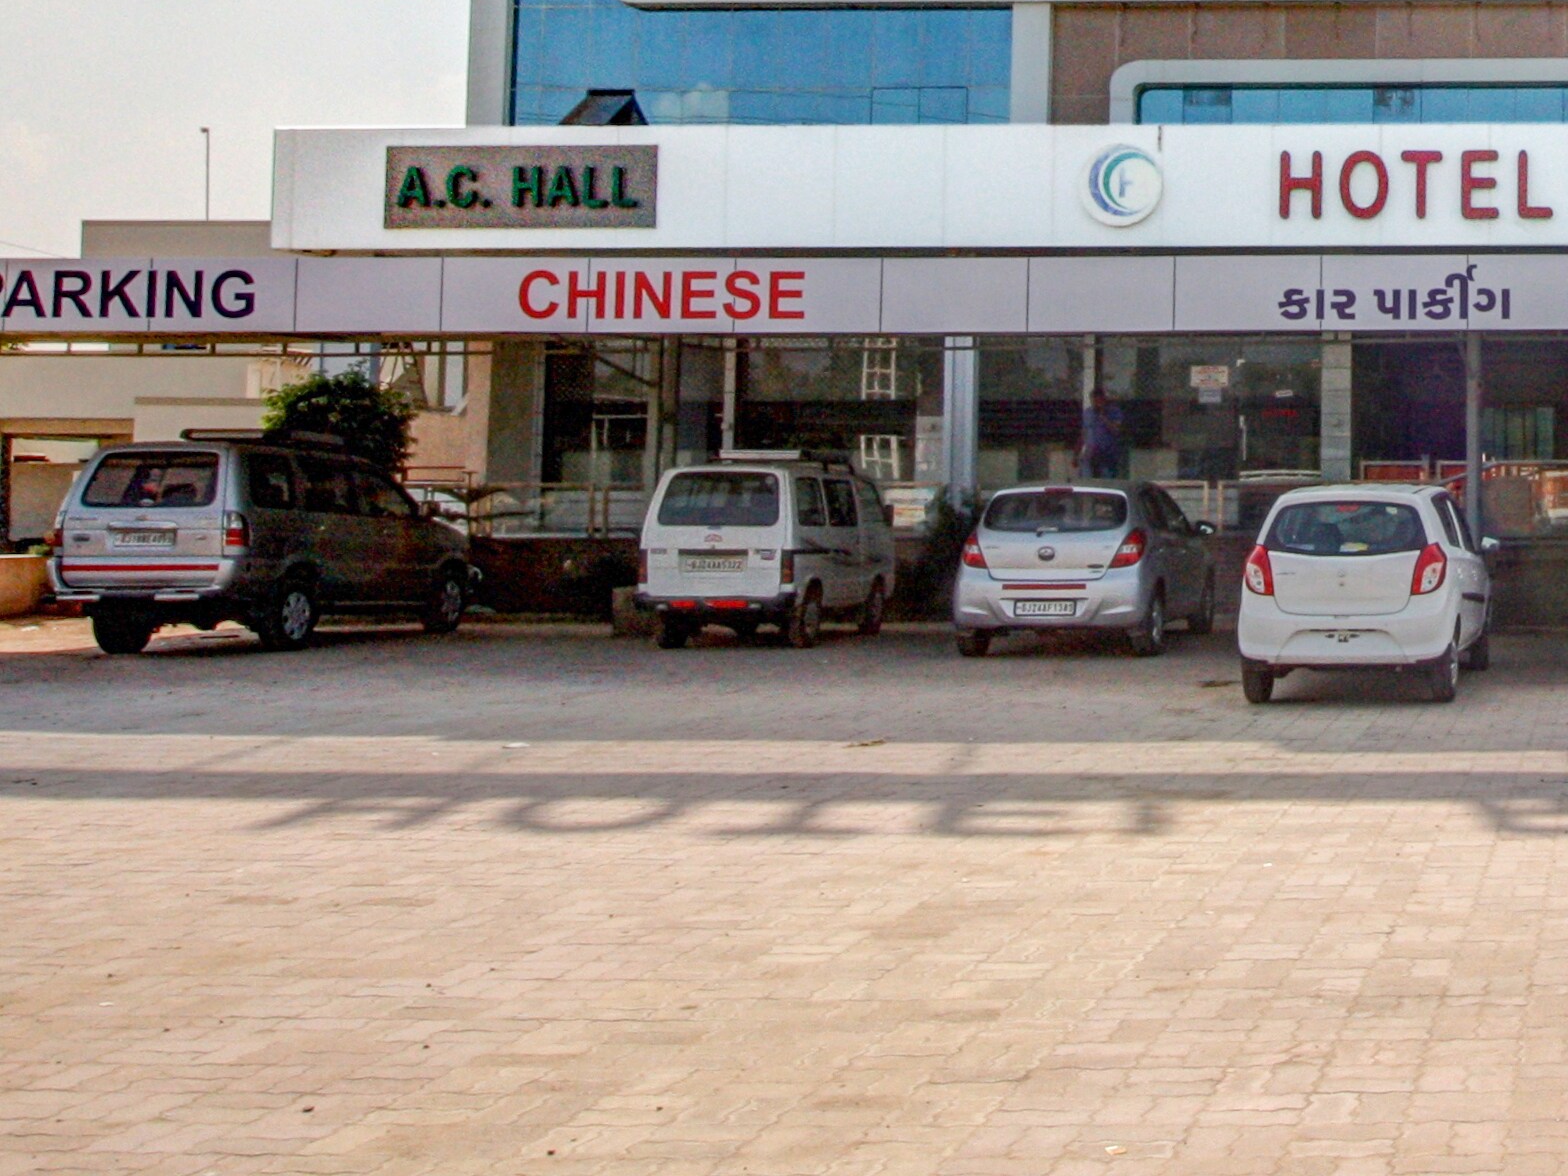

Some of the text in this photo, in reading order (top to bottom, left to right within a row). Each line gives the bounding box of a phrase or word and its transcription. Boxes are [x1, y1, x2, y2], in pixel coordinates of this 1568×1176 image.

[397, 165, 639, 208] A.C. HALL
[1279, 149, 1553, 219] HOTEL
[0, 269, 256, 319] ARKING
[518, 269, 806, 320] CHINESE
[1278, 288, 1356, 320] કાર
